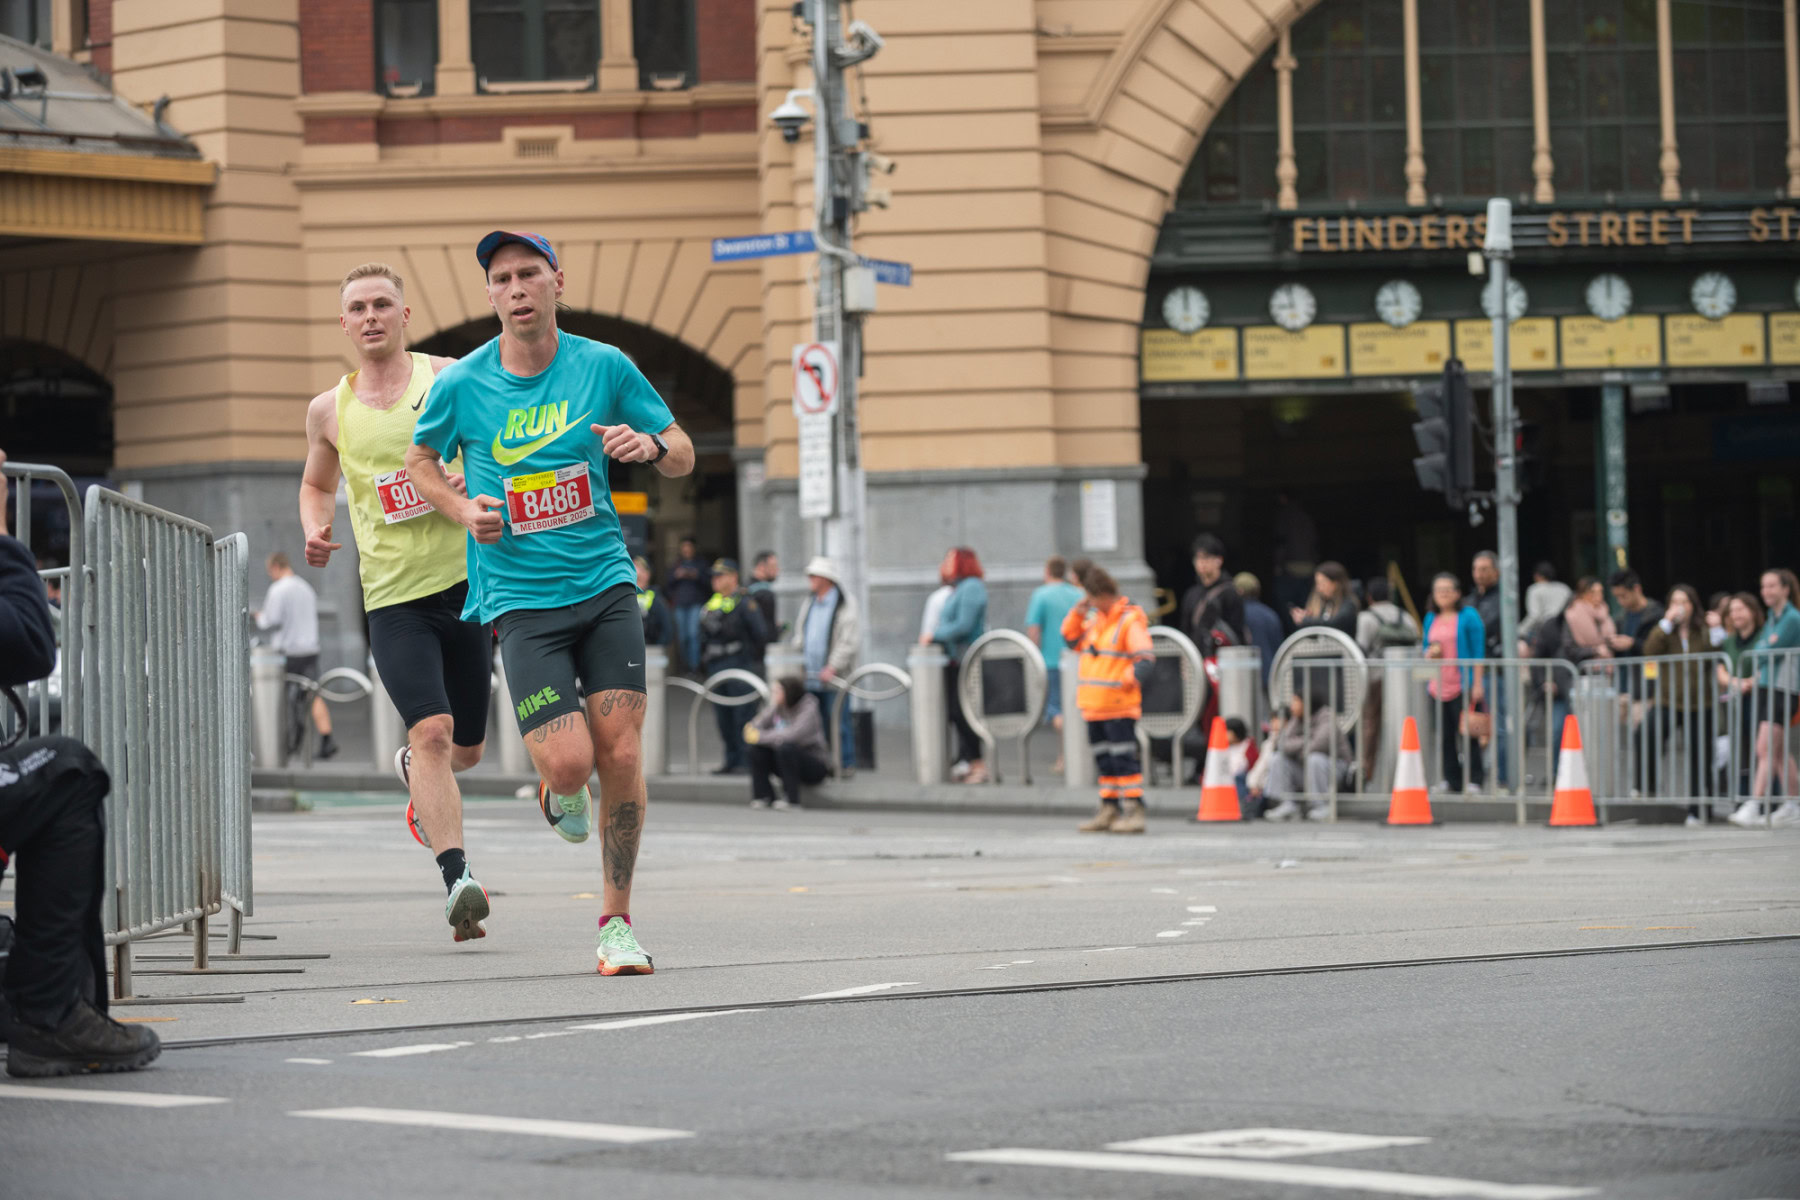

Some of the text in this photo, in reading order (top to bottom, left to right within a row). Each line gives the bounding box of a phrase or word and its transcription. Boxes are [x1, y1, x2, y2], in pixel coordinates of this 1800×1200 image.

[1293, 207, 1800, 252] FLINDERS STREET ST
[504, 400, 568, 439] RUN
[390, 481, 426, 509] 90
[392, 504, 433, 521] MELBOURNE
[522, 481, 581, 519] 8486
[520, 509, 588, 532] MELBOURNE 2025
[517, 686, 560, 721] NIKE
